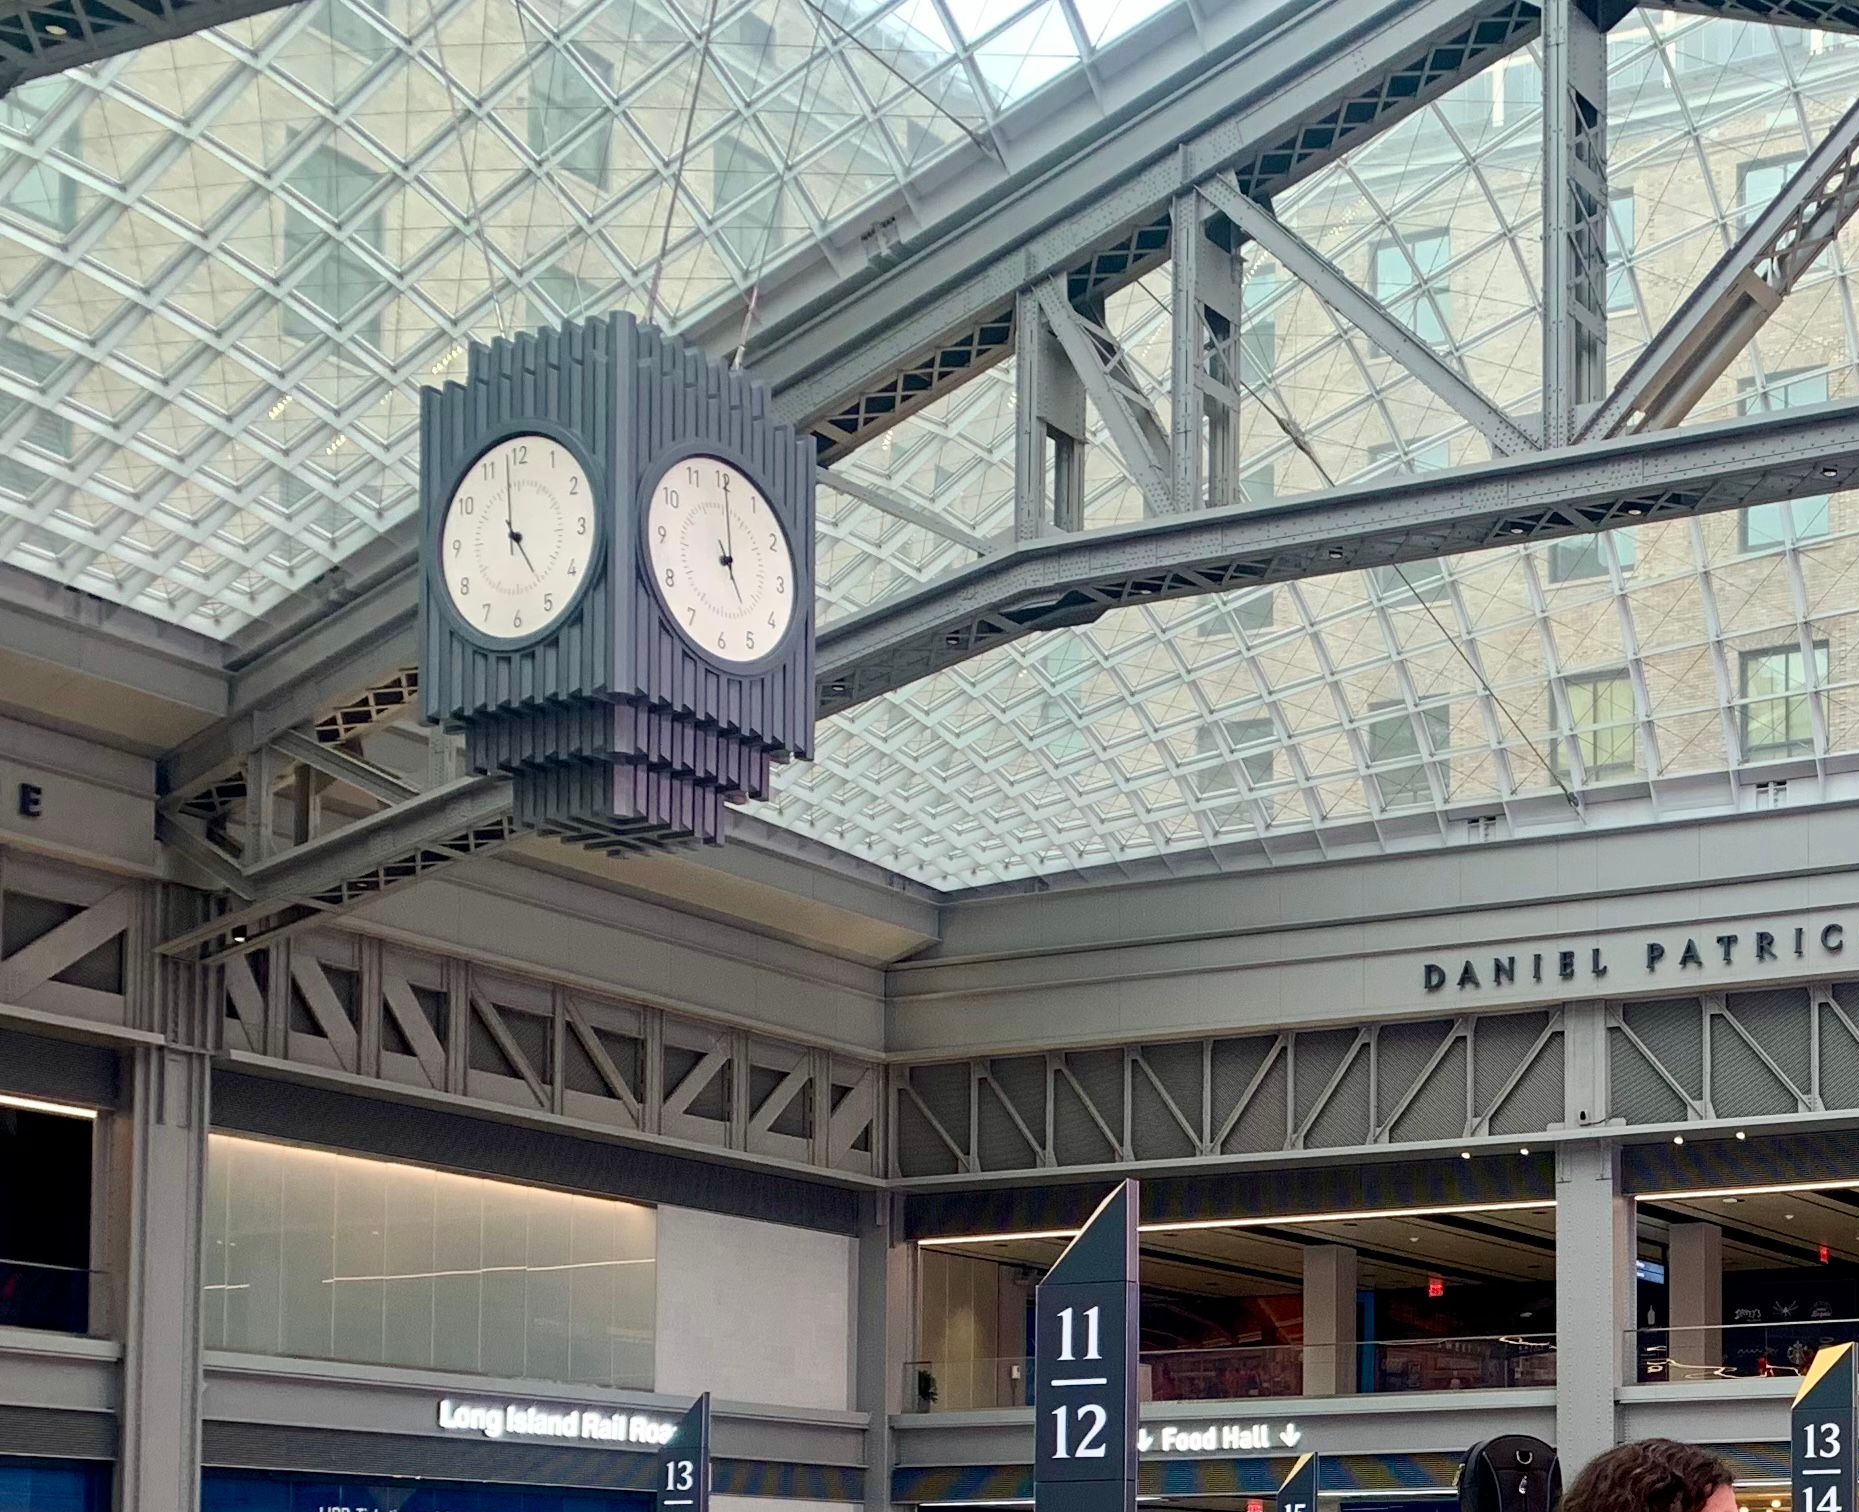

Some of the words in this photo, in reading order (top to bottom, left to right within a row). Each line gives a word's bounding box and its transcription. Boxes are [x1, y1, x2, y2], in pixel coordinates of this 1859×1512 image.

[511, 446, 528, 465] 12
[549, 450, 556, 468] 1
[481, 463, 496, 481] 11
[685, 466, 701, 488] 11
[715, 469, 731, 492] 12
[569, 476, 579, 495] 2
[458, 497, 474, 515] 10
[663, 486, 680, 509] 10
[751, 495, 757, 513] 1
[576, 517, 586, 535] 3
[657, 525, 667, 544] 9
[452, 539, 462, 557] 9
[769, 533, 778, 552] 2
[567, 559, 577, 576] 4
[460, 577, 470, 595] 8
[664, 568, 675, 587] 8
[776, 576, 785, 594] 3
[543, 593, 553, 611] 5
[482, 604, 491, 622] 7
[512, 610, 522, 628] 6
[687, 607, 697, 626] 7
[767, 611, 776, 629] 4
[717, 632, 726, 650] 6
[745, 631, 755, 649] 5
[1424, 947, 1608, 991] DANIEL
[1056, 1305, 1103, 1361] 11
[439, 1400, 504, 1438] Long
[506, 1405, 580, 1437] Island
[581, 1412, 628, 1441] Rail
[629, 1416, 678, 1445] Roa
[1051, 1403, 1107, 1459] 12
[1161, 1426, 1217, 1451] Food
[1222, 1424, 1270, 1449] Hall
[1803, 1422, 1841, 1459] 13
[665, 1460, 694, 1491] 13
